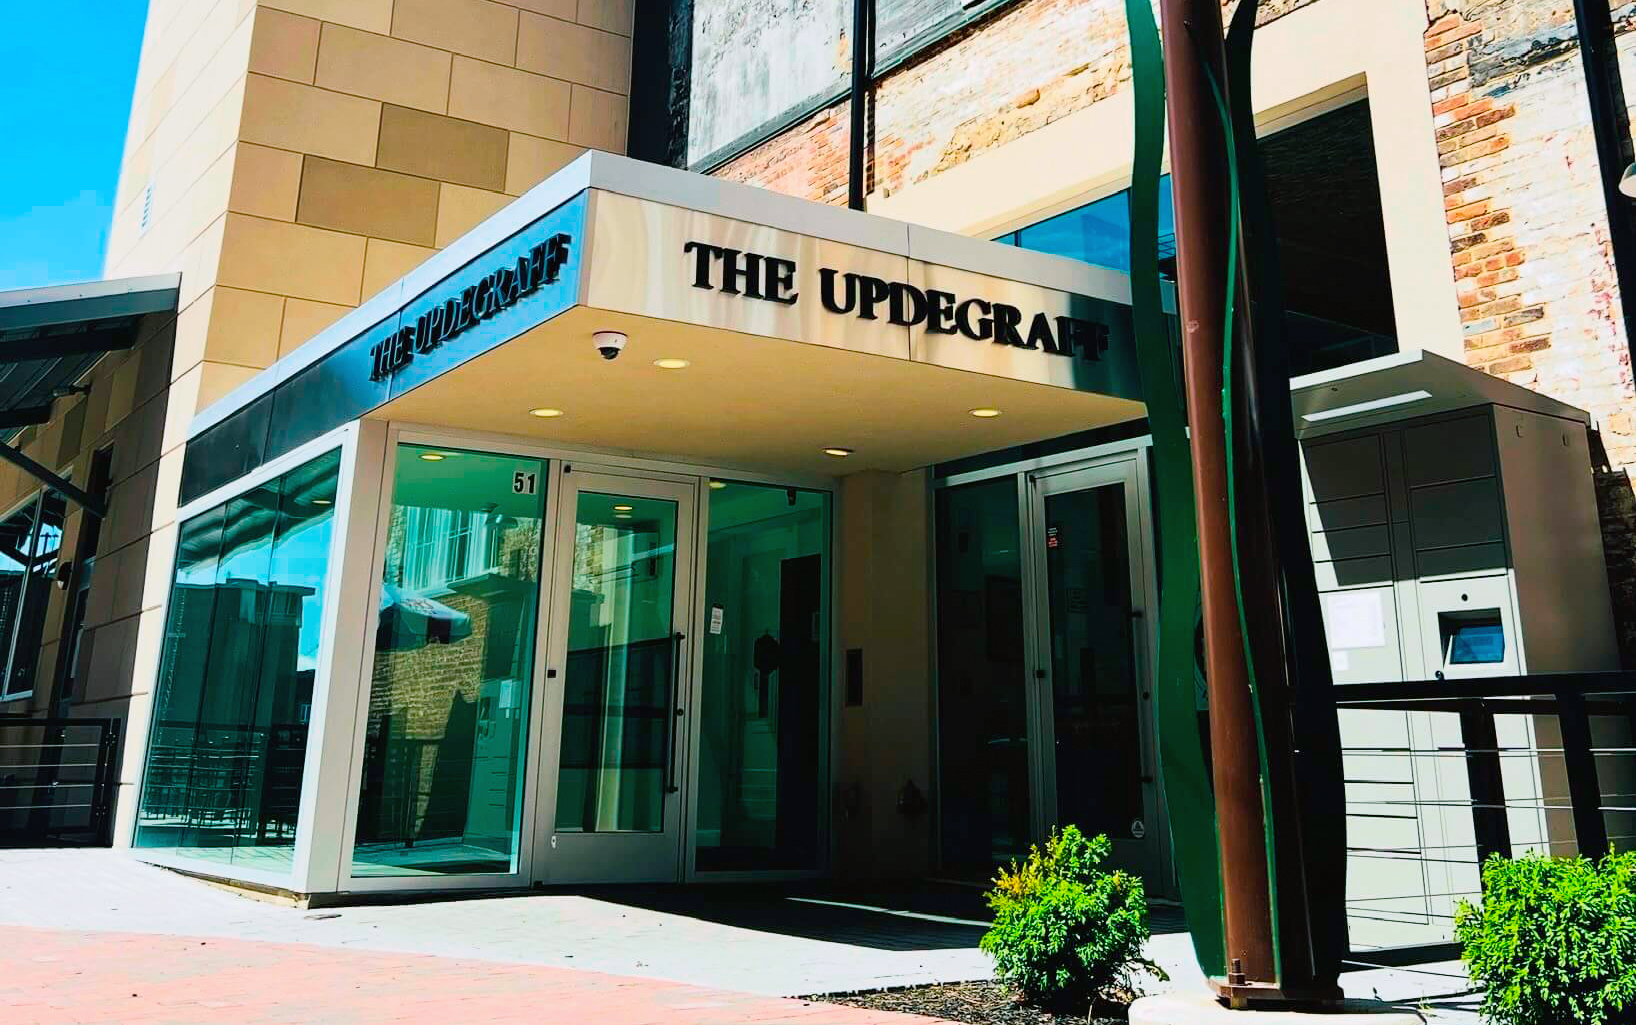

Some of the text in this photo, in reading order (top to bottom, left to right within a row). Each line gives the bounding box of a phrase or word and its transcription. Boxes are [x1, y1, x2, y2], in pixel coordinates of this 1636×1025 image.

[369, 233, 571, 381] THE UPDEGRAFF
[684, 241, 1110, 361] THE UPDEGRAFF
[514, 472, 536, 494] 51
